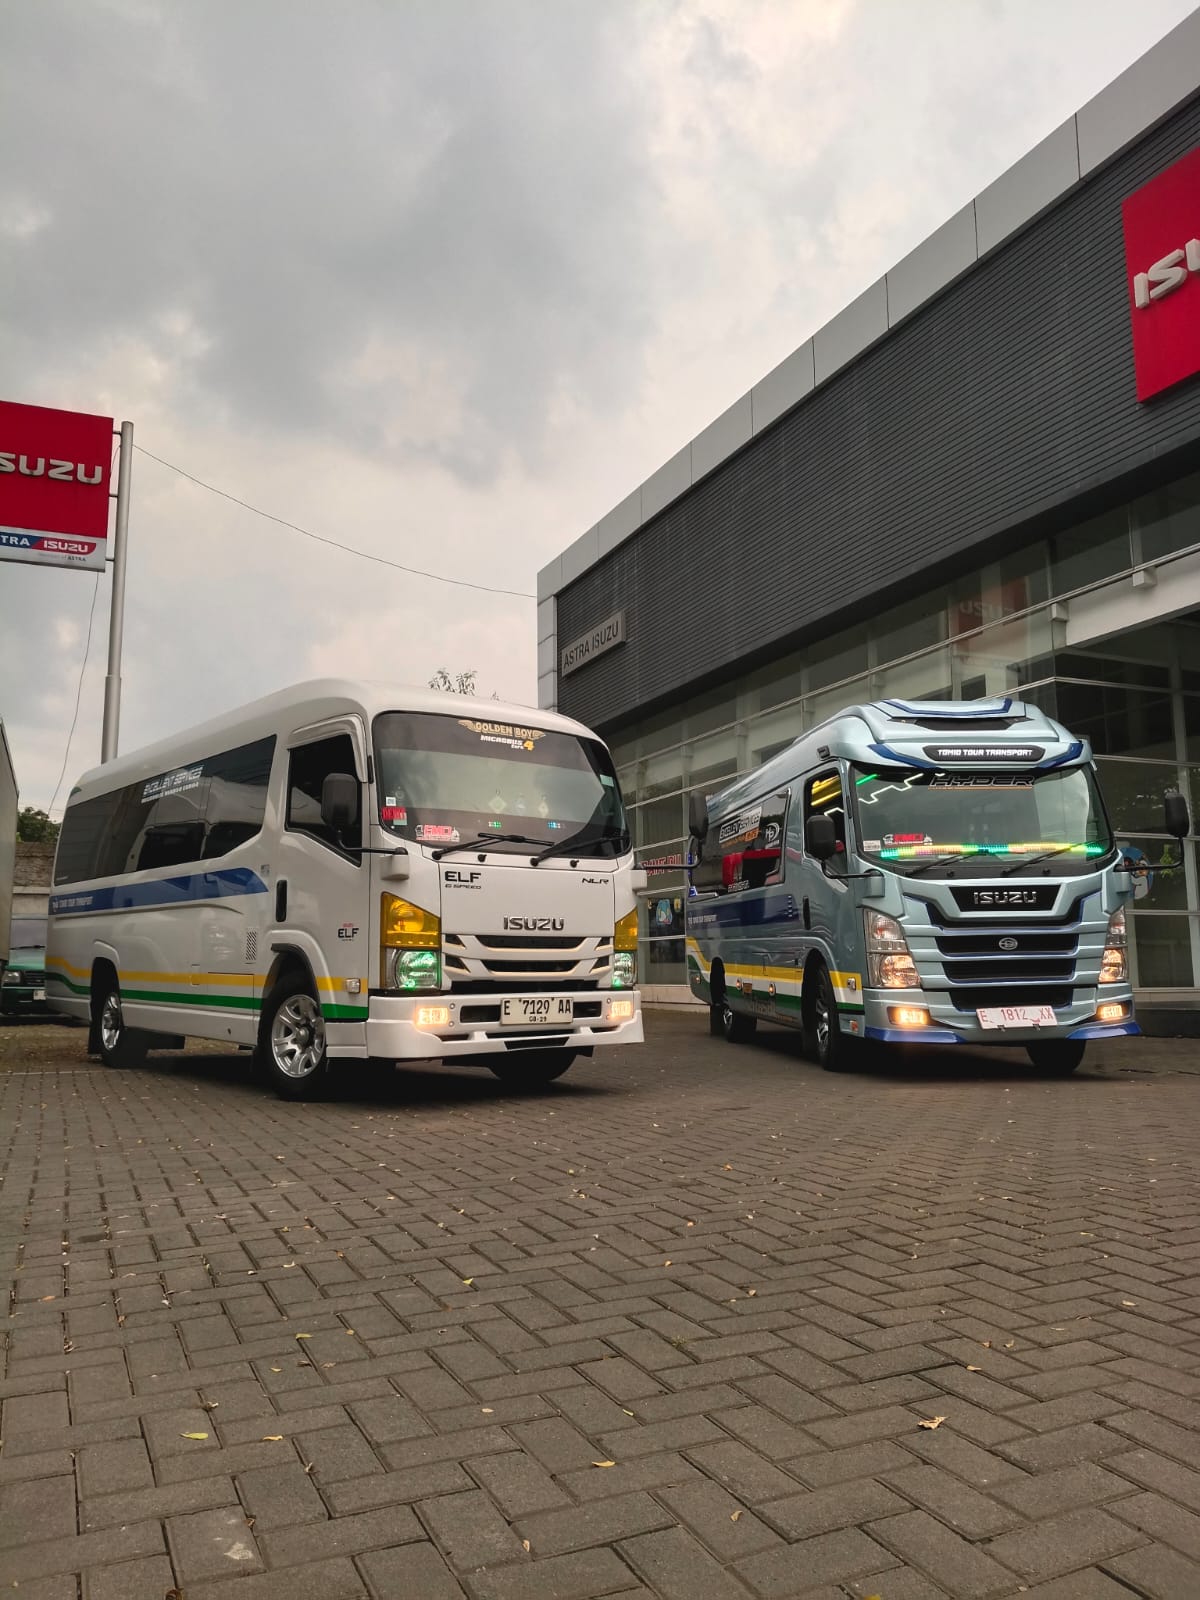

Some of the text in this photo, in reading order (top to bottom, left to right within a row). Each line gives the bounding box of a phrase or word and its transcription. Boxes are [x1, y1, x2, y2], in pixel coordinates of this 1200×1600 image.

[43, 540, 88, 553] ISUZU
[563, 620, 619, 669] ASTRA ISUZU
[475, 722, 533, 739] GOLDEN BOY
[524, 740, 535, 751] 4
[444, 871, 481, 883] ELF
[581, 877, 609, 885] NLR
[974, 891, 1037, 905] ISUZU
[503, 917, 565, 931] ISUZU
[338, 928, 359, 938] ELF
[503, 999, 571, 1015] E 7129 AA
[979, 1007, 1054, 1023] E 1812 XX
